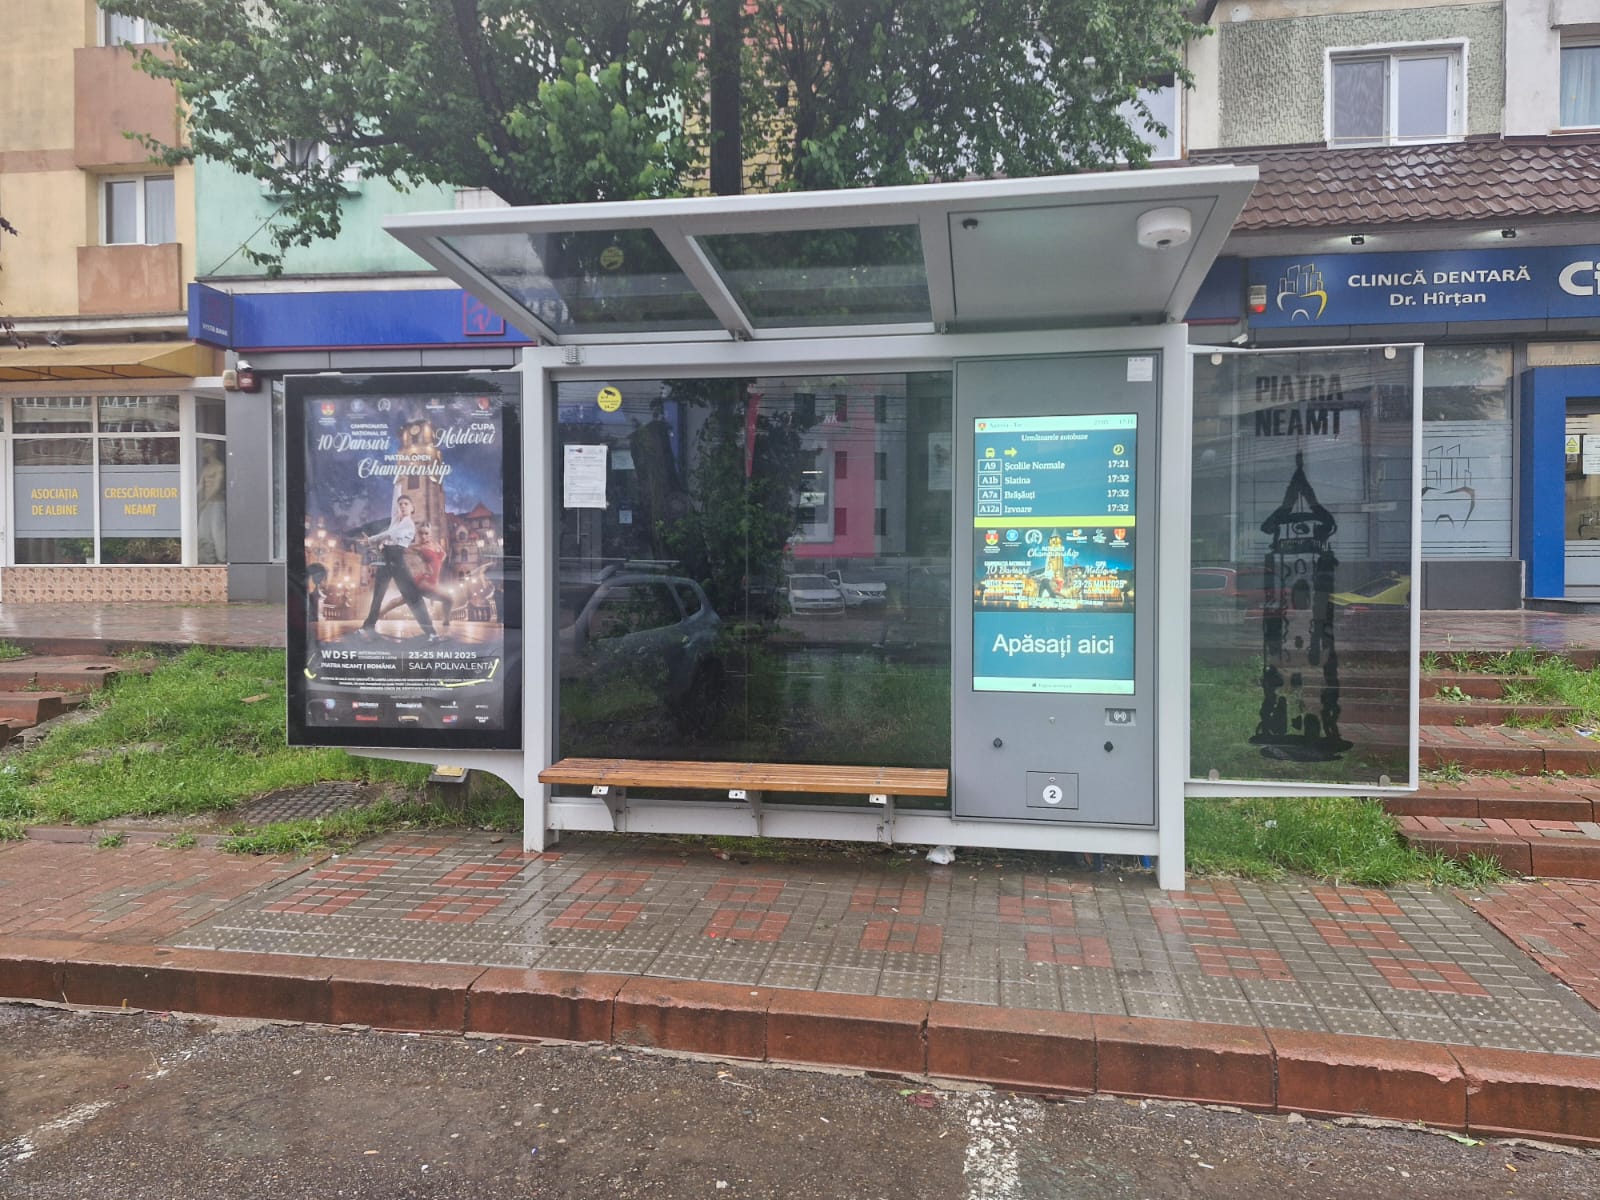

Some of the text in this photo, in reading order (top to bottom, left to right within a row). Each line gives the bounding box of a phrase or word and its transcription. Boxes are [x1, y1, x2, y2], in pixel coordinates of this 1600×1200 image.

[1348, 265, 1531, 288] CLINICĂ DENTARĂ
[1389, 291, 1487, 307] Dr. Hîrțan
[1255, 373, 1343, 402] PIATRA
[471, 423, 496, 431] CUPA
[1255, 407, 1344, 440] NEAMȚ
[318, 433, 391, 452] 10 Dansuri
[432, 427, 496, 449] Moldovei
[384, 454, 411, 462] PIATRA
[357, 457, 453, 485] Championship
[984, 462, 997, 471] A9
[1032, 461, 1066, 470] Normale
[1107, 460, 1129, 468] 17:21
[982, 475, 1130, 485] A1b Slatina 17:32
[104, 485, 177, 499] CRESCĂTORILOR
[982, 491, 999, 499] A7a
[1107, 489, 1130, 498] 17:32
[31, 504, 44, 516] DE
[45, 504, 79, 516] ALBINE
[979, 504, 1129, 513] A12a Izvoare 17:32
[992, 633, 1114, 658] Apăsați aici
[320, 649, 357, 660] WDSF
[408, 651, 434, 660] 23-25
[436, 651, 453, 660] MAI
[454, 651, 477, 660] 2025
[408, 662, 433, 670] SALA
[1048, 790, 1057, 799] 2
